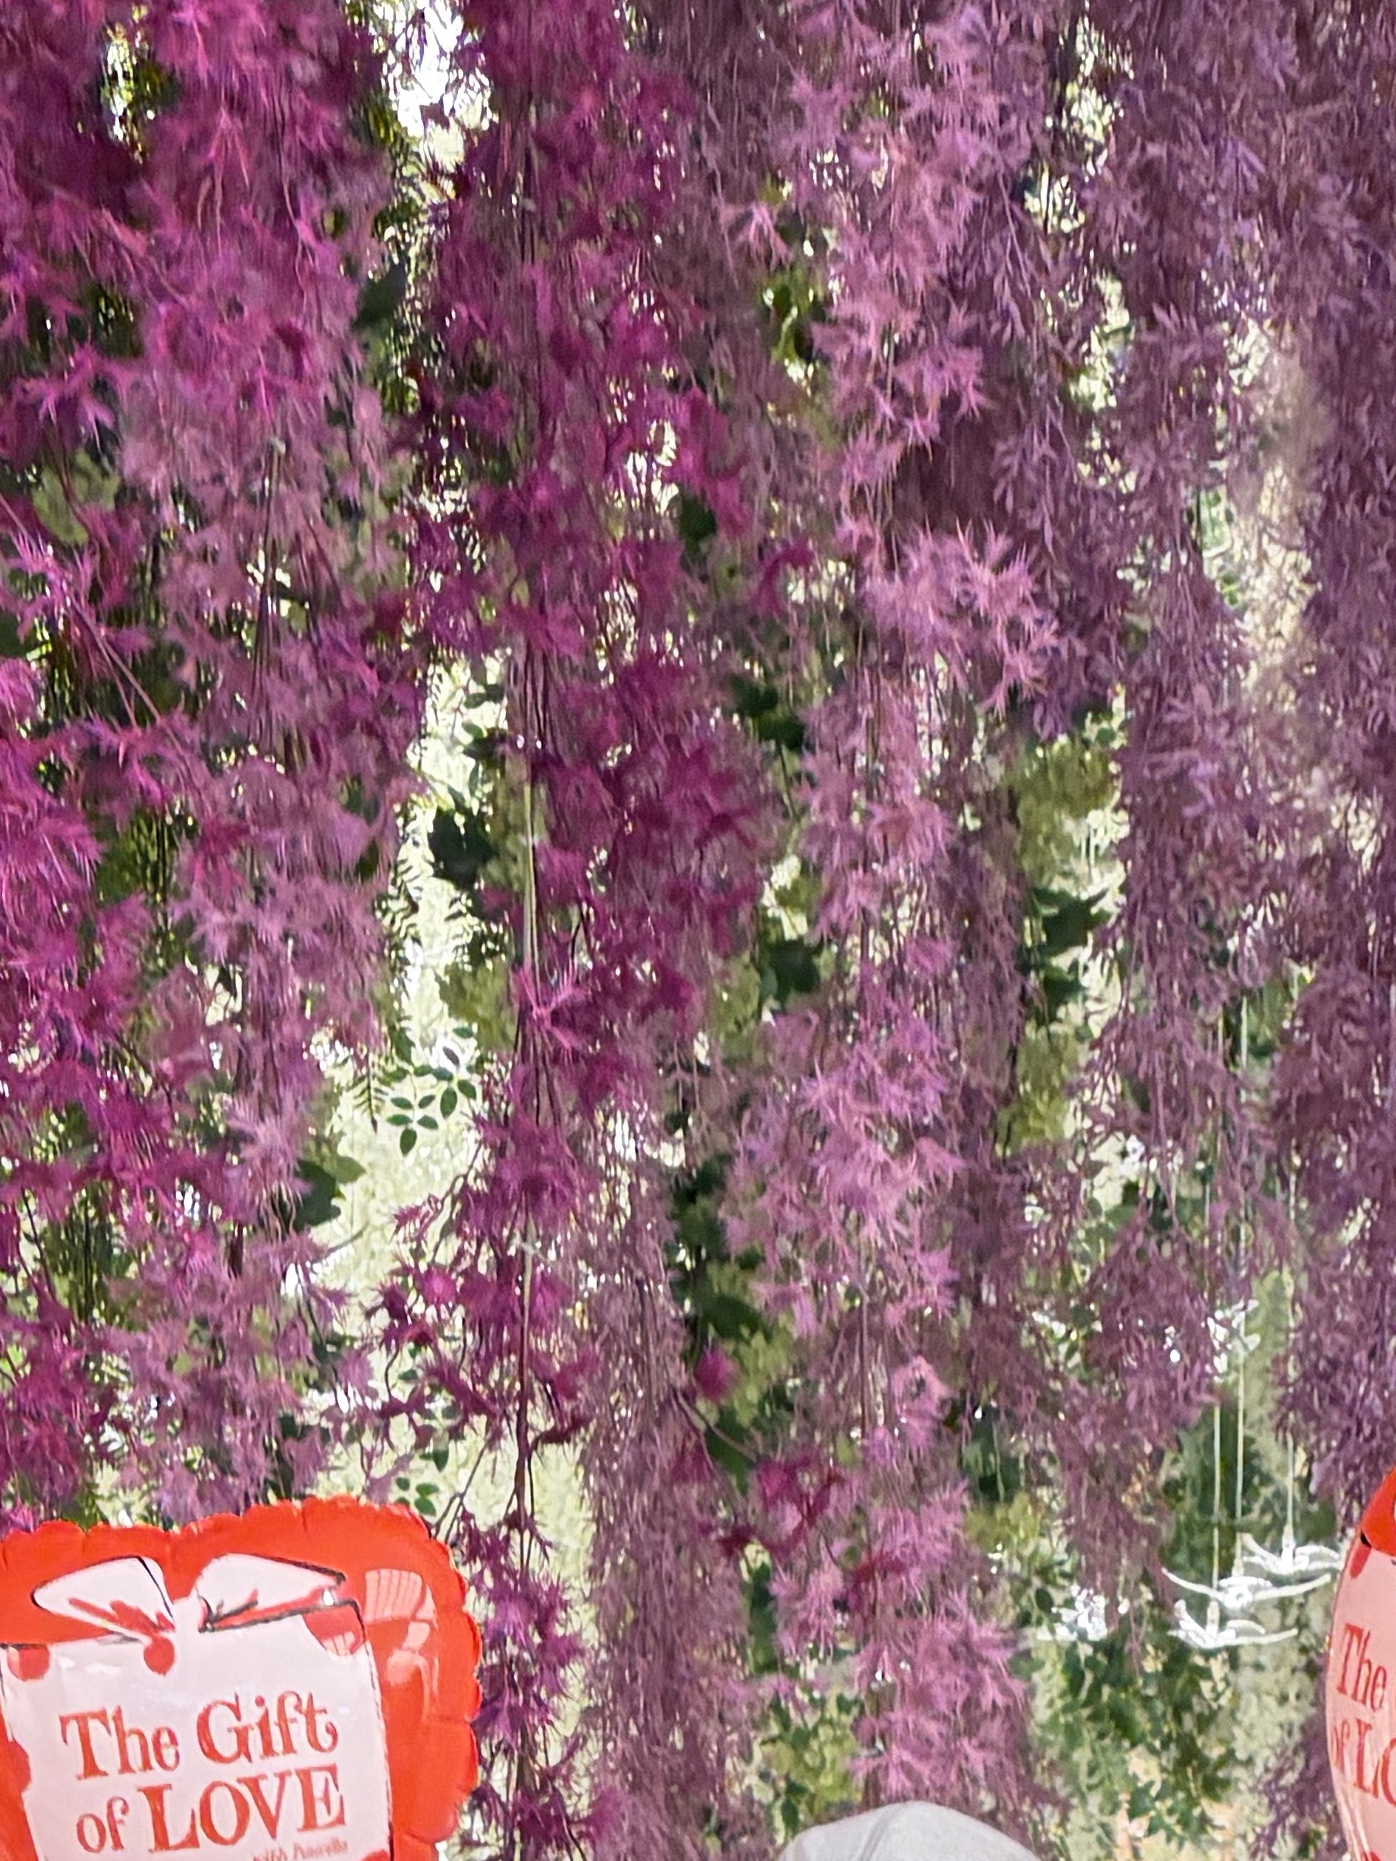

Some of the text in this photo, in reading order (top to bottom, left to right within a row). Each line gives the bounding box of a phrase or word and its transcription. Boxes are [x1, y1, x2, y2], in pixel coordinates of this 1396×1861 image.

[1337, 1623, 1387, 1711] The
[58, 1690, 339, 1781] The Gift
[75, 1763, 347, 1855] of LOVE
